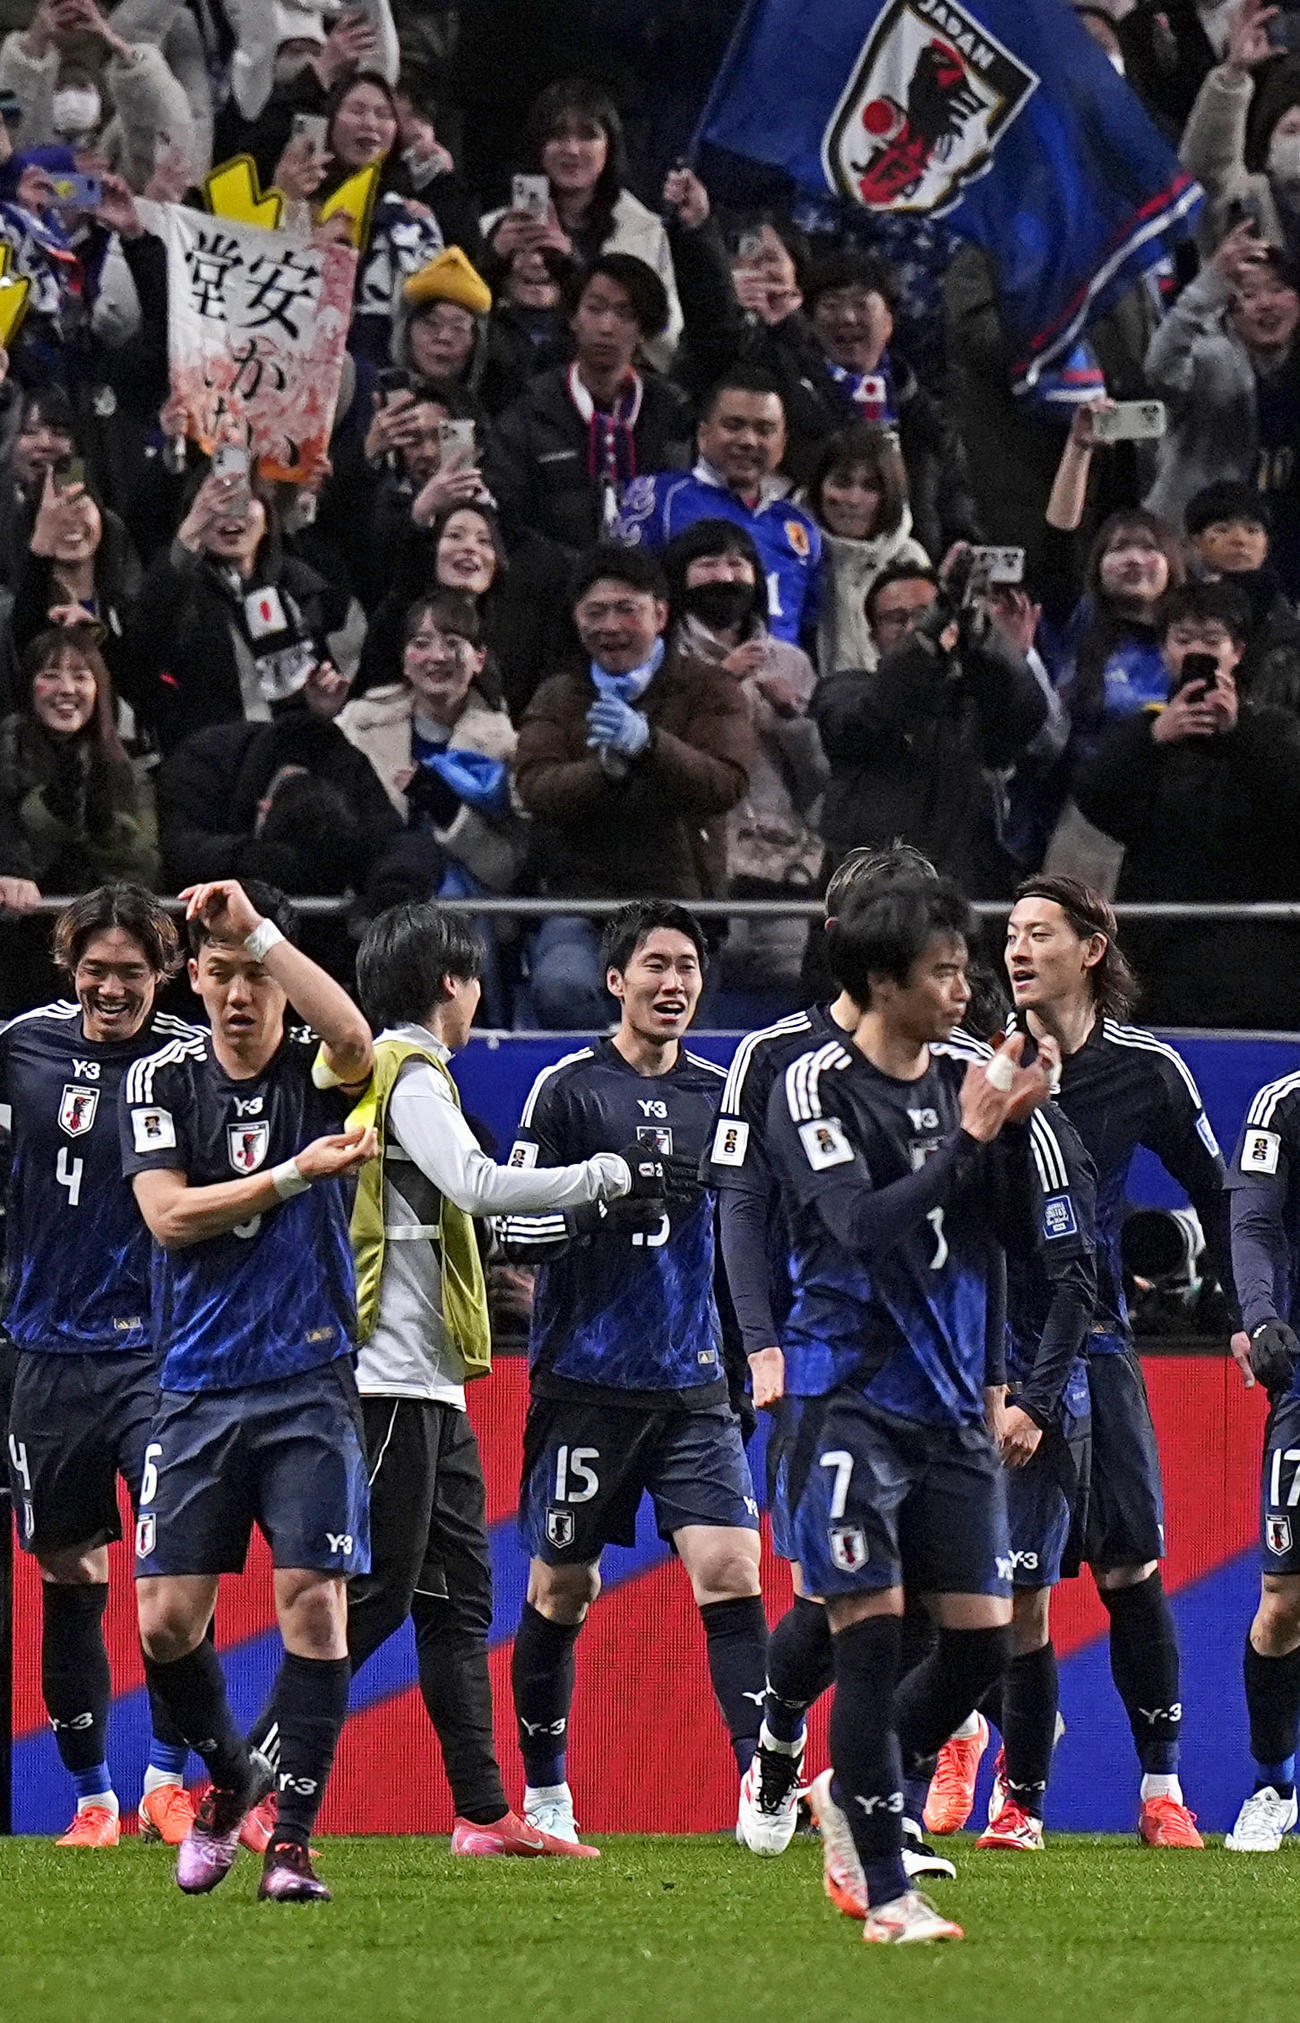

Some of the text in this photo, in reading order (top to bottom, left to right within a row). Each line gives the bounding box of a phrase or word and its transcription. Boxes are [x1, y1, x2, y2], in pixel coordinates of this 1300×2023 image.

[184, 232, 319, 340] 堂安
[72, 1058, 101, 1080] Y-3
[233, 1096, 264, 1117] Y-3
[637, 1099, 668, 1119] Y-3
[56, 1147, 84, 1206] 4
[8, 1434, 31, 1491] 4
[140, 1443, 163, 1506] 6
[555, 1445, 600, 1503] 15
[819, 1450, 855, 1519] 7
[1270, 1448, 1300, 1507] 17
[325, 1532, 353, 1555] Y-3
[1008, 1549, 1039, 1570] Y-3
[1138, 1702, 1182, 1725] Y-3
[520, 1716, 566, 1737] Y-3
[279, 1772, 318, 1796] Y-3
[854, 1791, 905, 1815] Y-3
